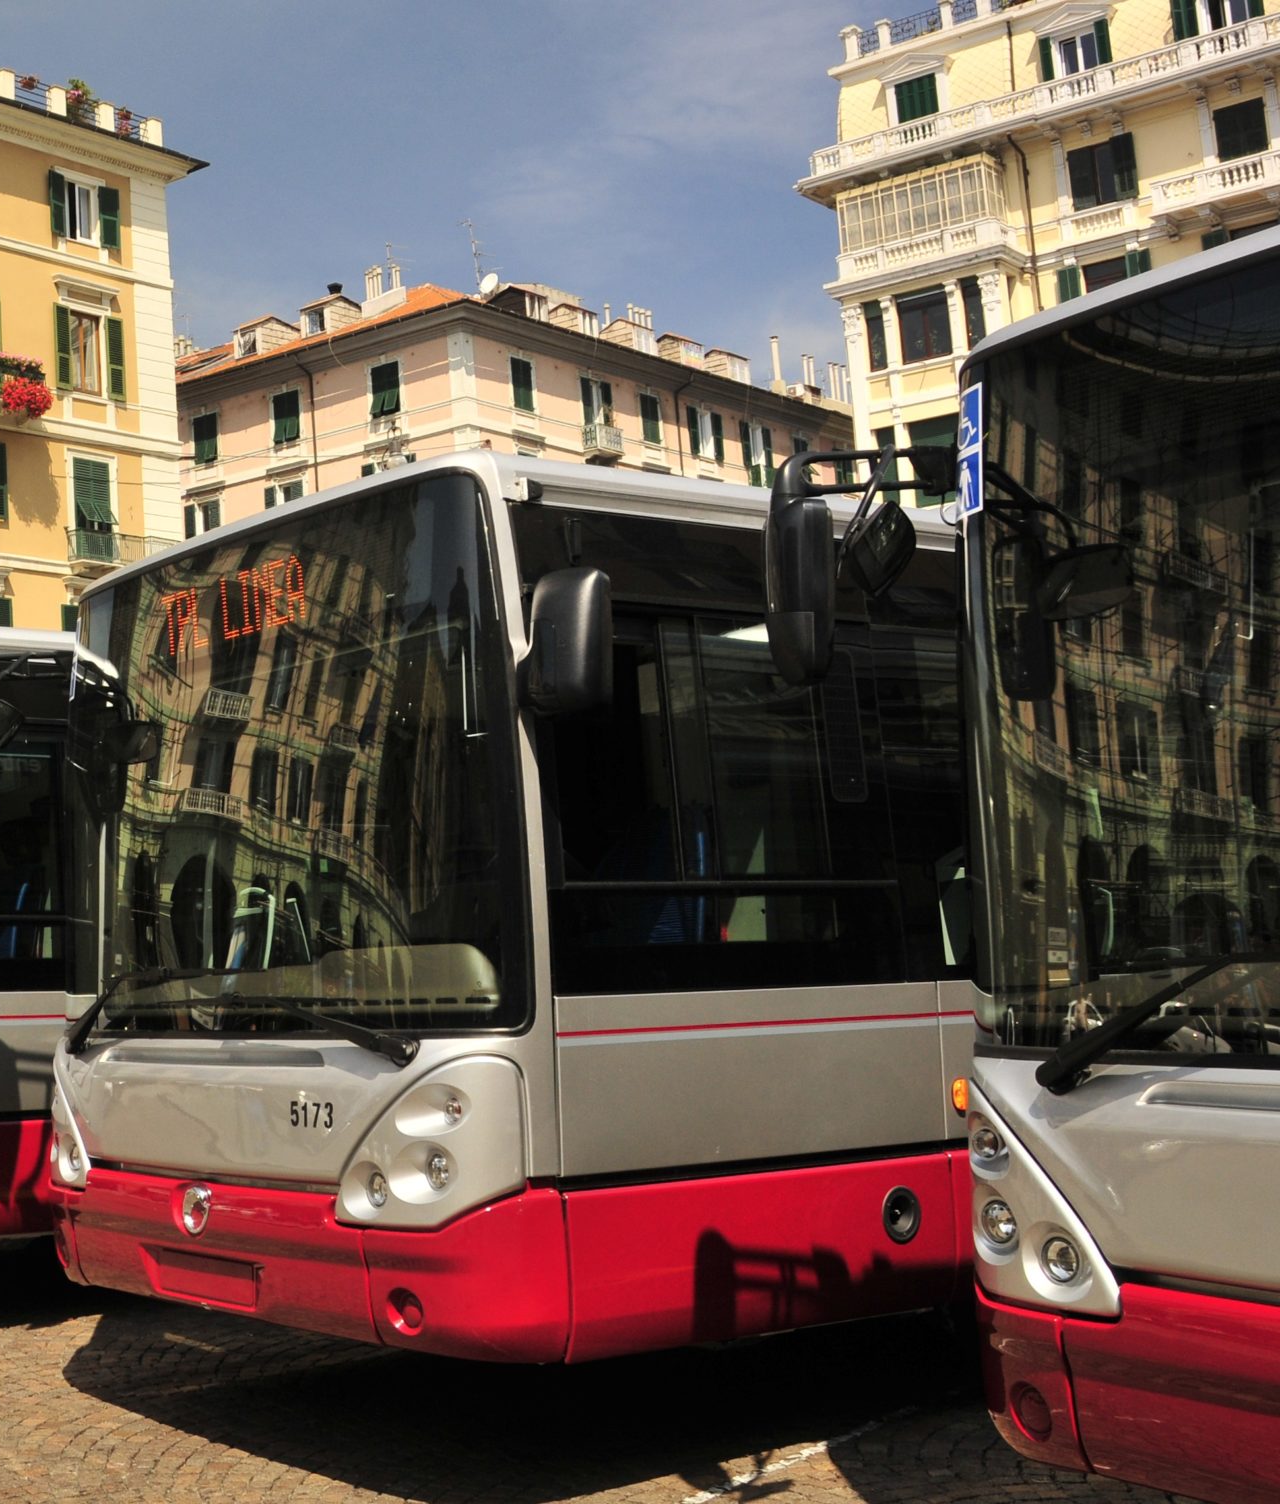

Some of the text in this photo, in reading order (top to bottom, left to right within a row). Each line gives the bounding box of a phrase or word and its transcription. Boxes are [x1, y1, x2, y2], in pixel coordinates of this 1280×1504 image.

[161, 553, 306, 656] TPL LINEA
[290, 1100, 334, 1129] 5173
